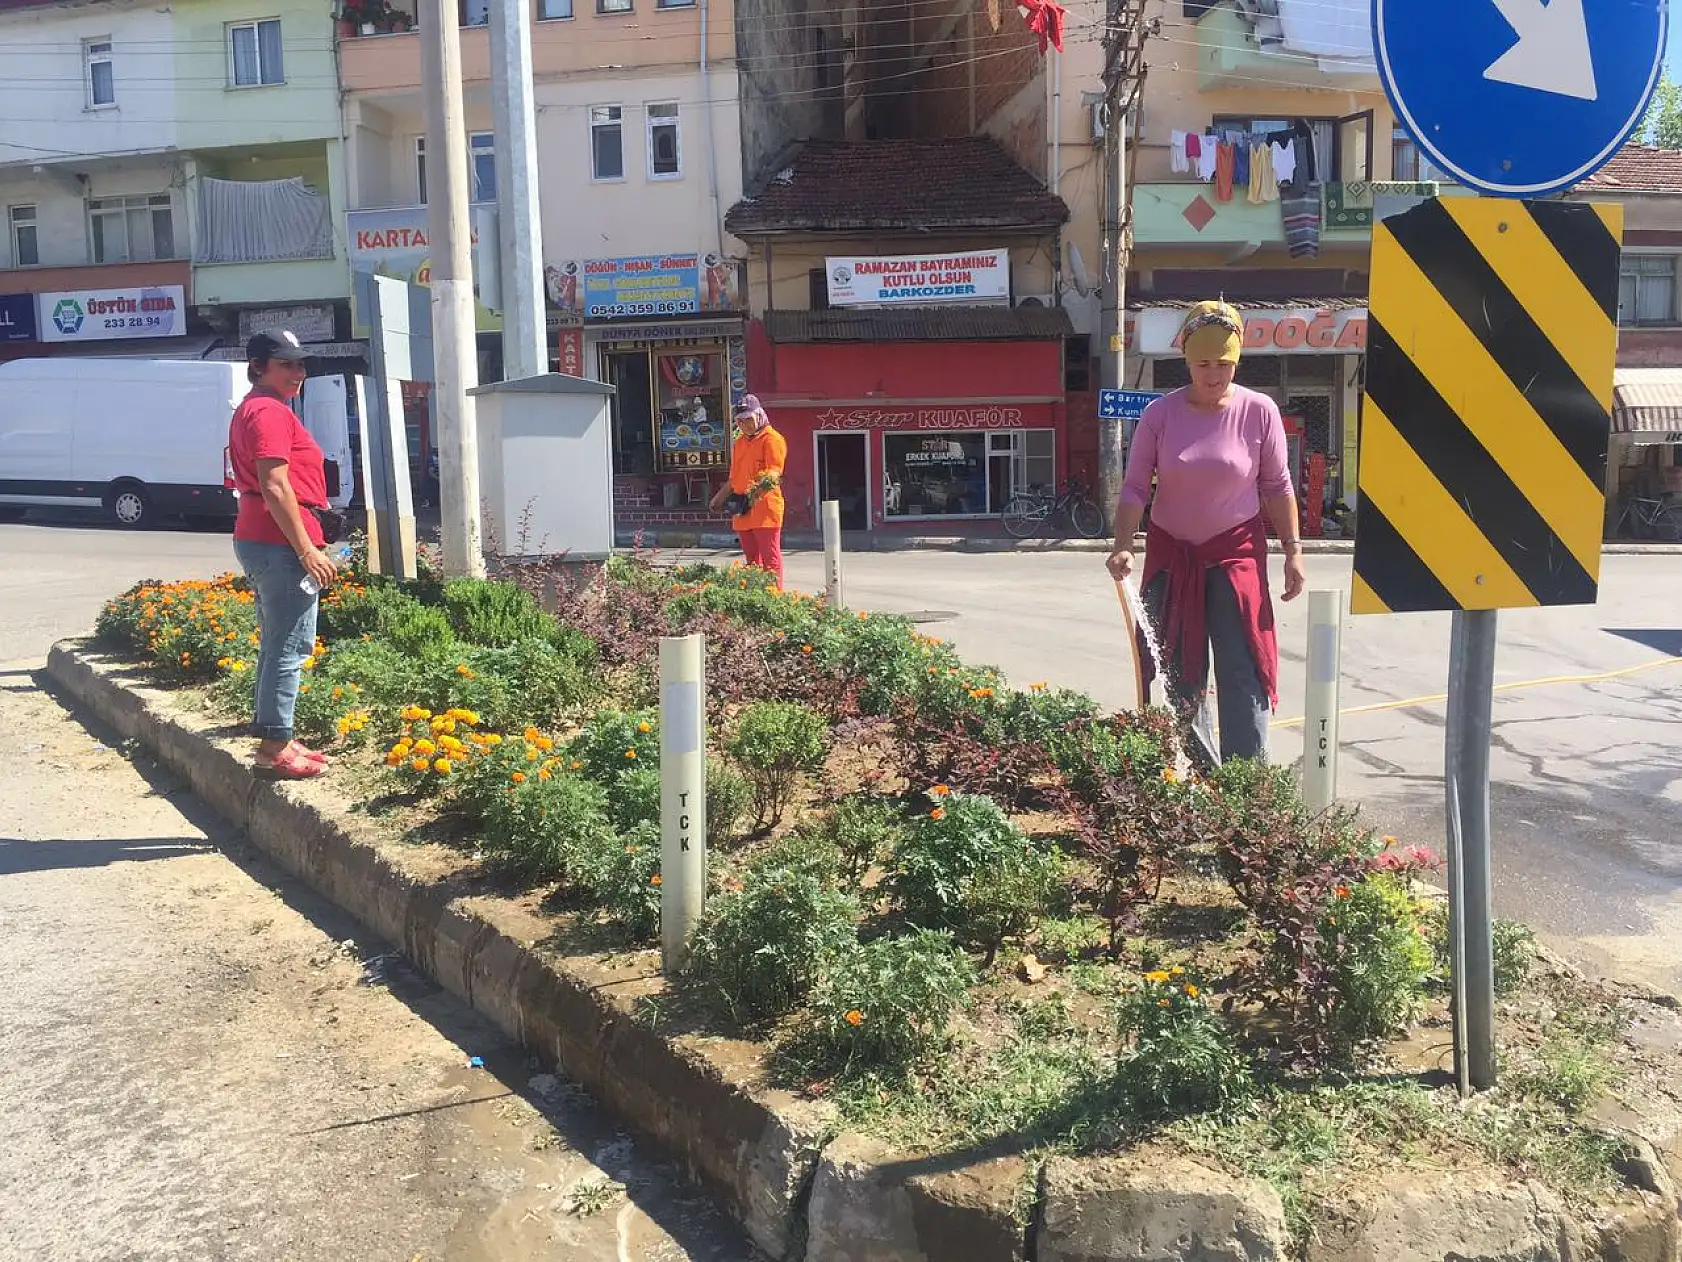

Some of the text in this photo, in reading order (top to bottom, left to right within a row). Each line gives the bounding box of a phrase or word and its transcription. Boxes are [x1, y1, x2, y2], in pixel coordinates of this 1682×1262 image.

[357, 227, 429, 249] KARTA
[854, 256, 998, 275] RAMAZAN BAYRAMINIZ
[882, 271, 972, 288] KUTLU OLSUN
[879, 285, 977, 299] BARKOZDER
[591, 301, 696, 315] 0542 359 86 91
[104, 316, 160, 329] 233 28 94
[843, 405, 1024, 429] Star KUAFÖR
[1319, 719, 1327, 768] TCK
[679, 794, 690, 851] TCK
